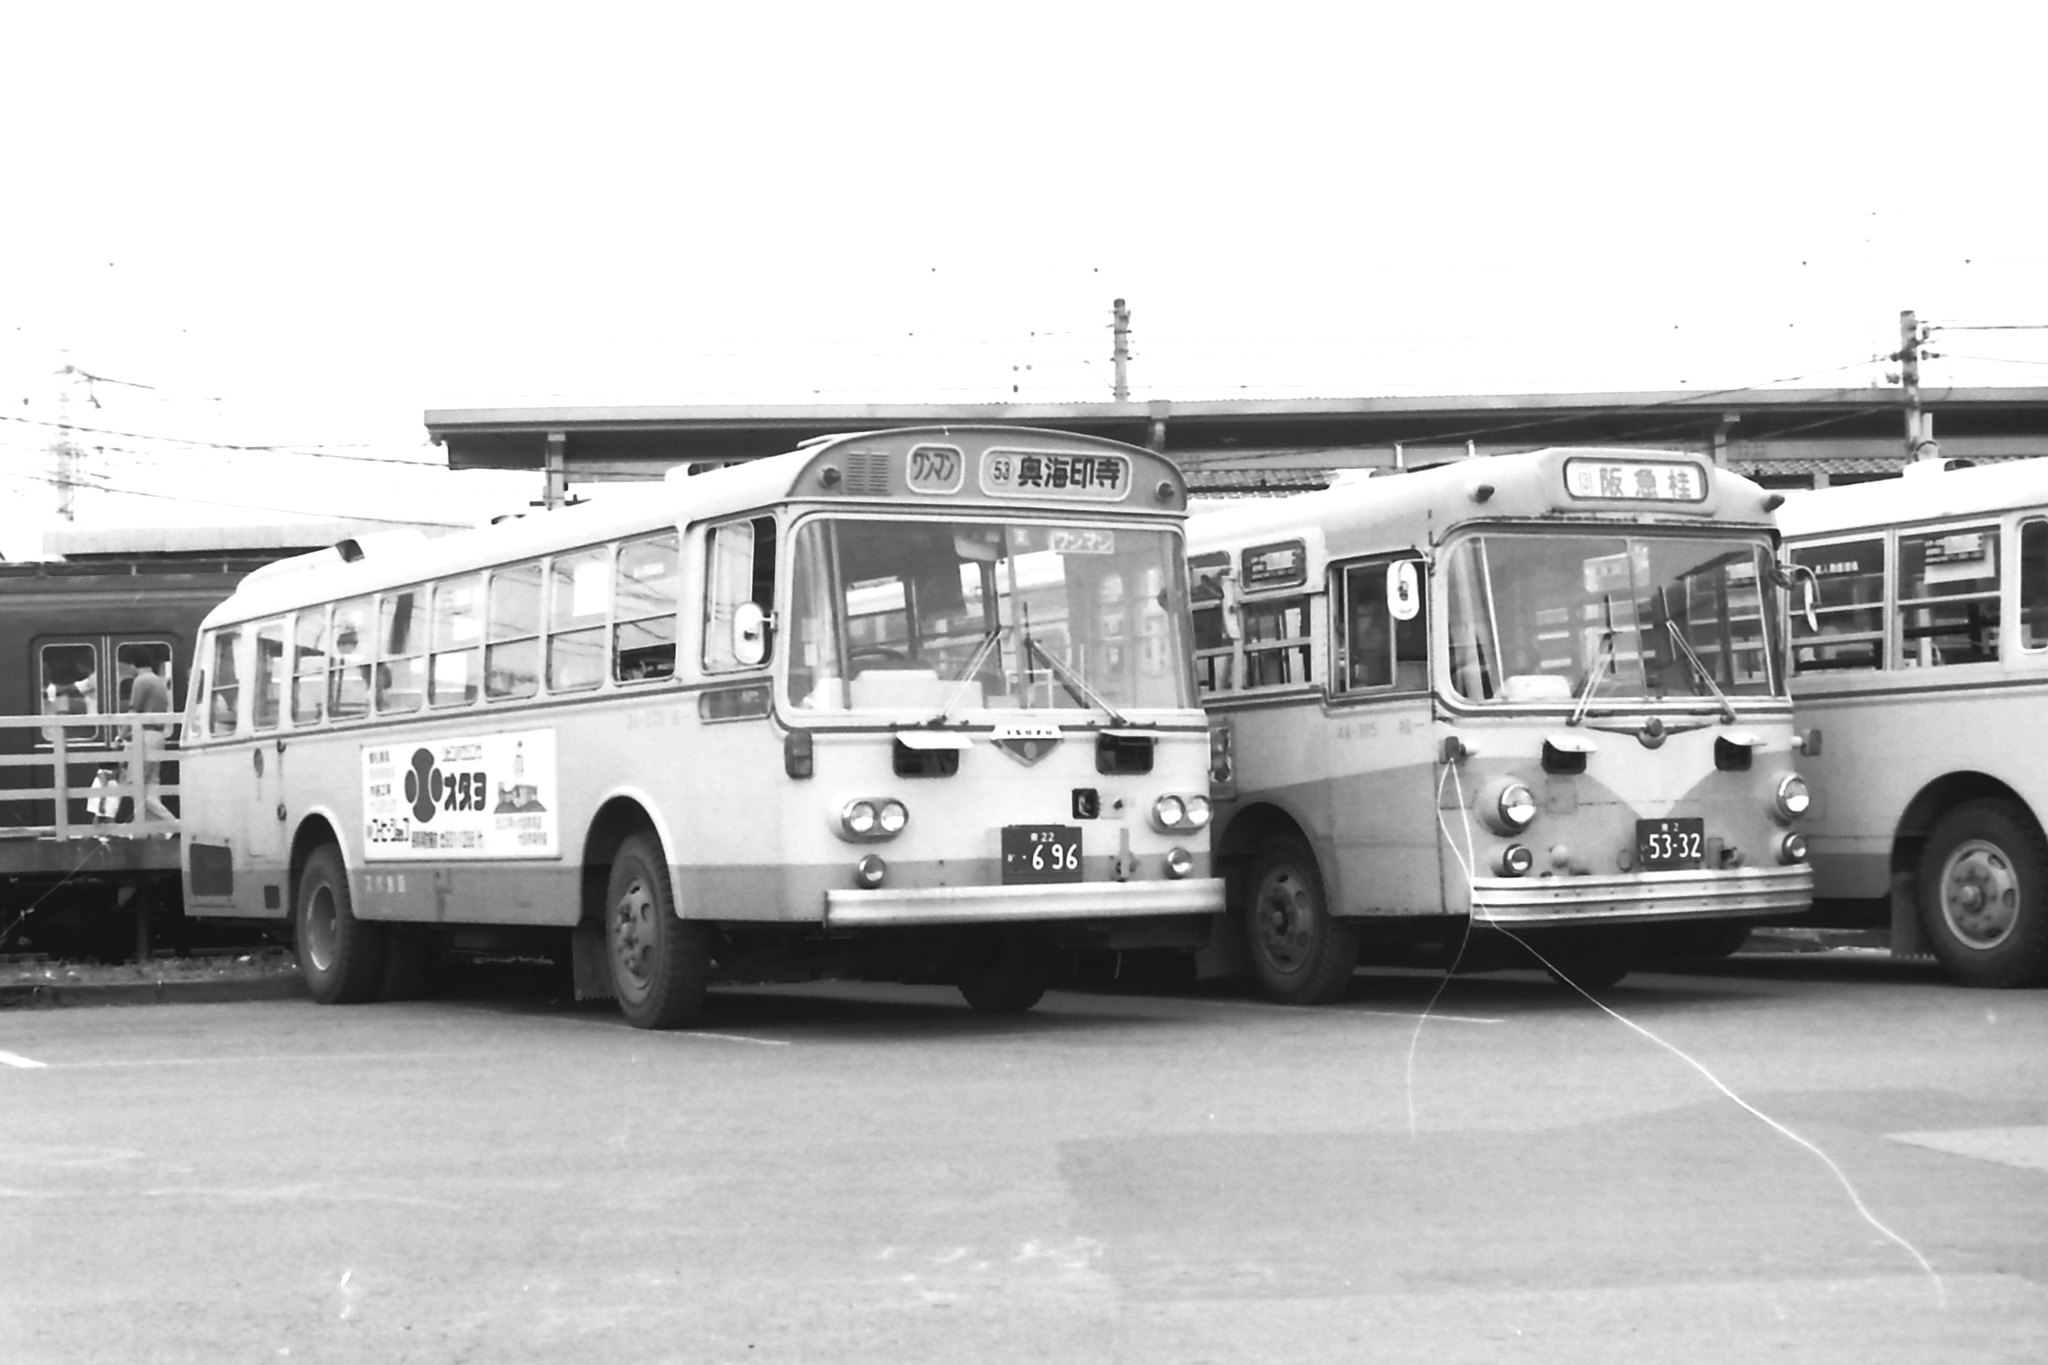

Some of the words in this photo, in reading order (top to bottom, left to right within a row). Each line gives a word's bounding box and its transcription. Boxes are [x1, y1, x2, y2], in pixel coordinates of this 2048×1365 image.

[912, 452, 955, 481] ワンマン
[1017, 456, 1121, 489] 奥海印寺
[1599, 467, 1692, 499] 阪急桂
[1055, 531, 1111, 550] ワンマン
